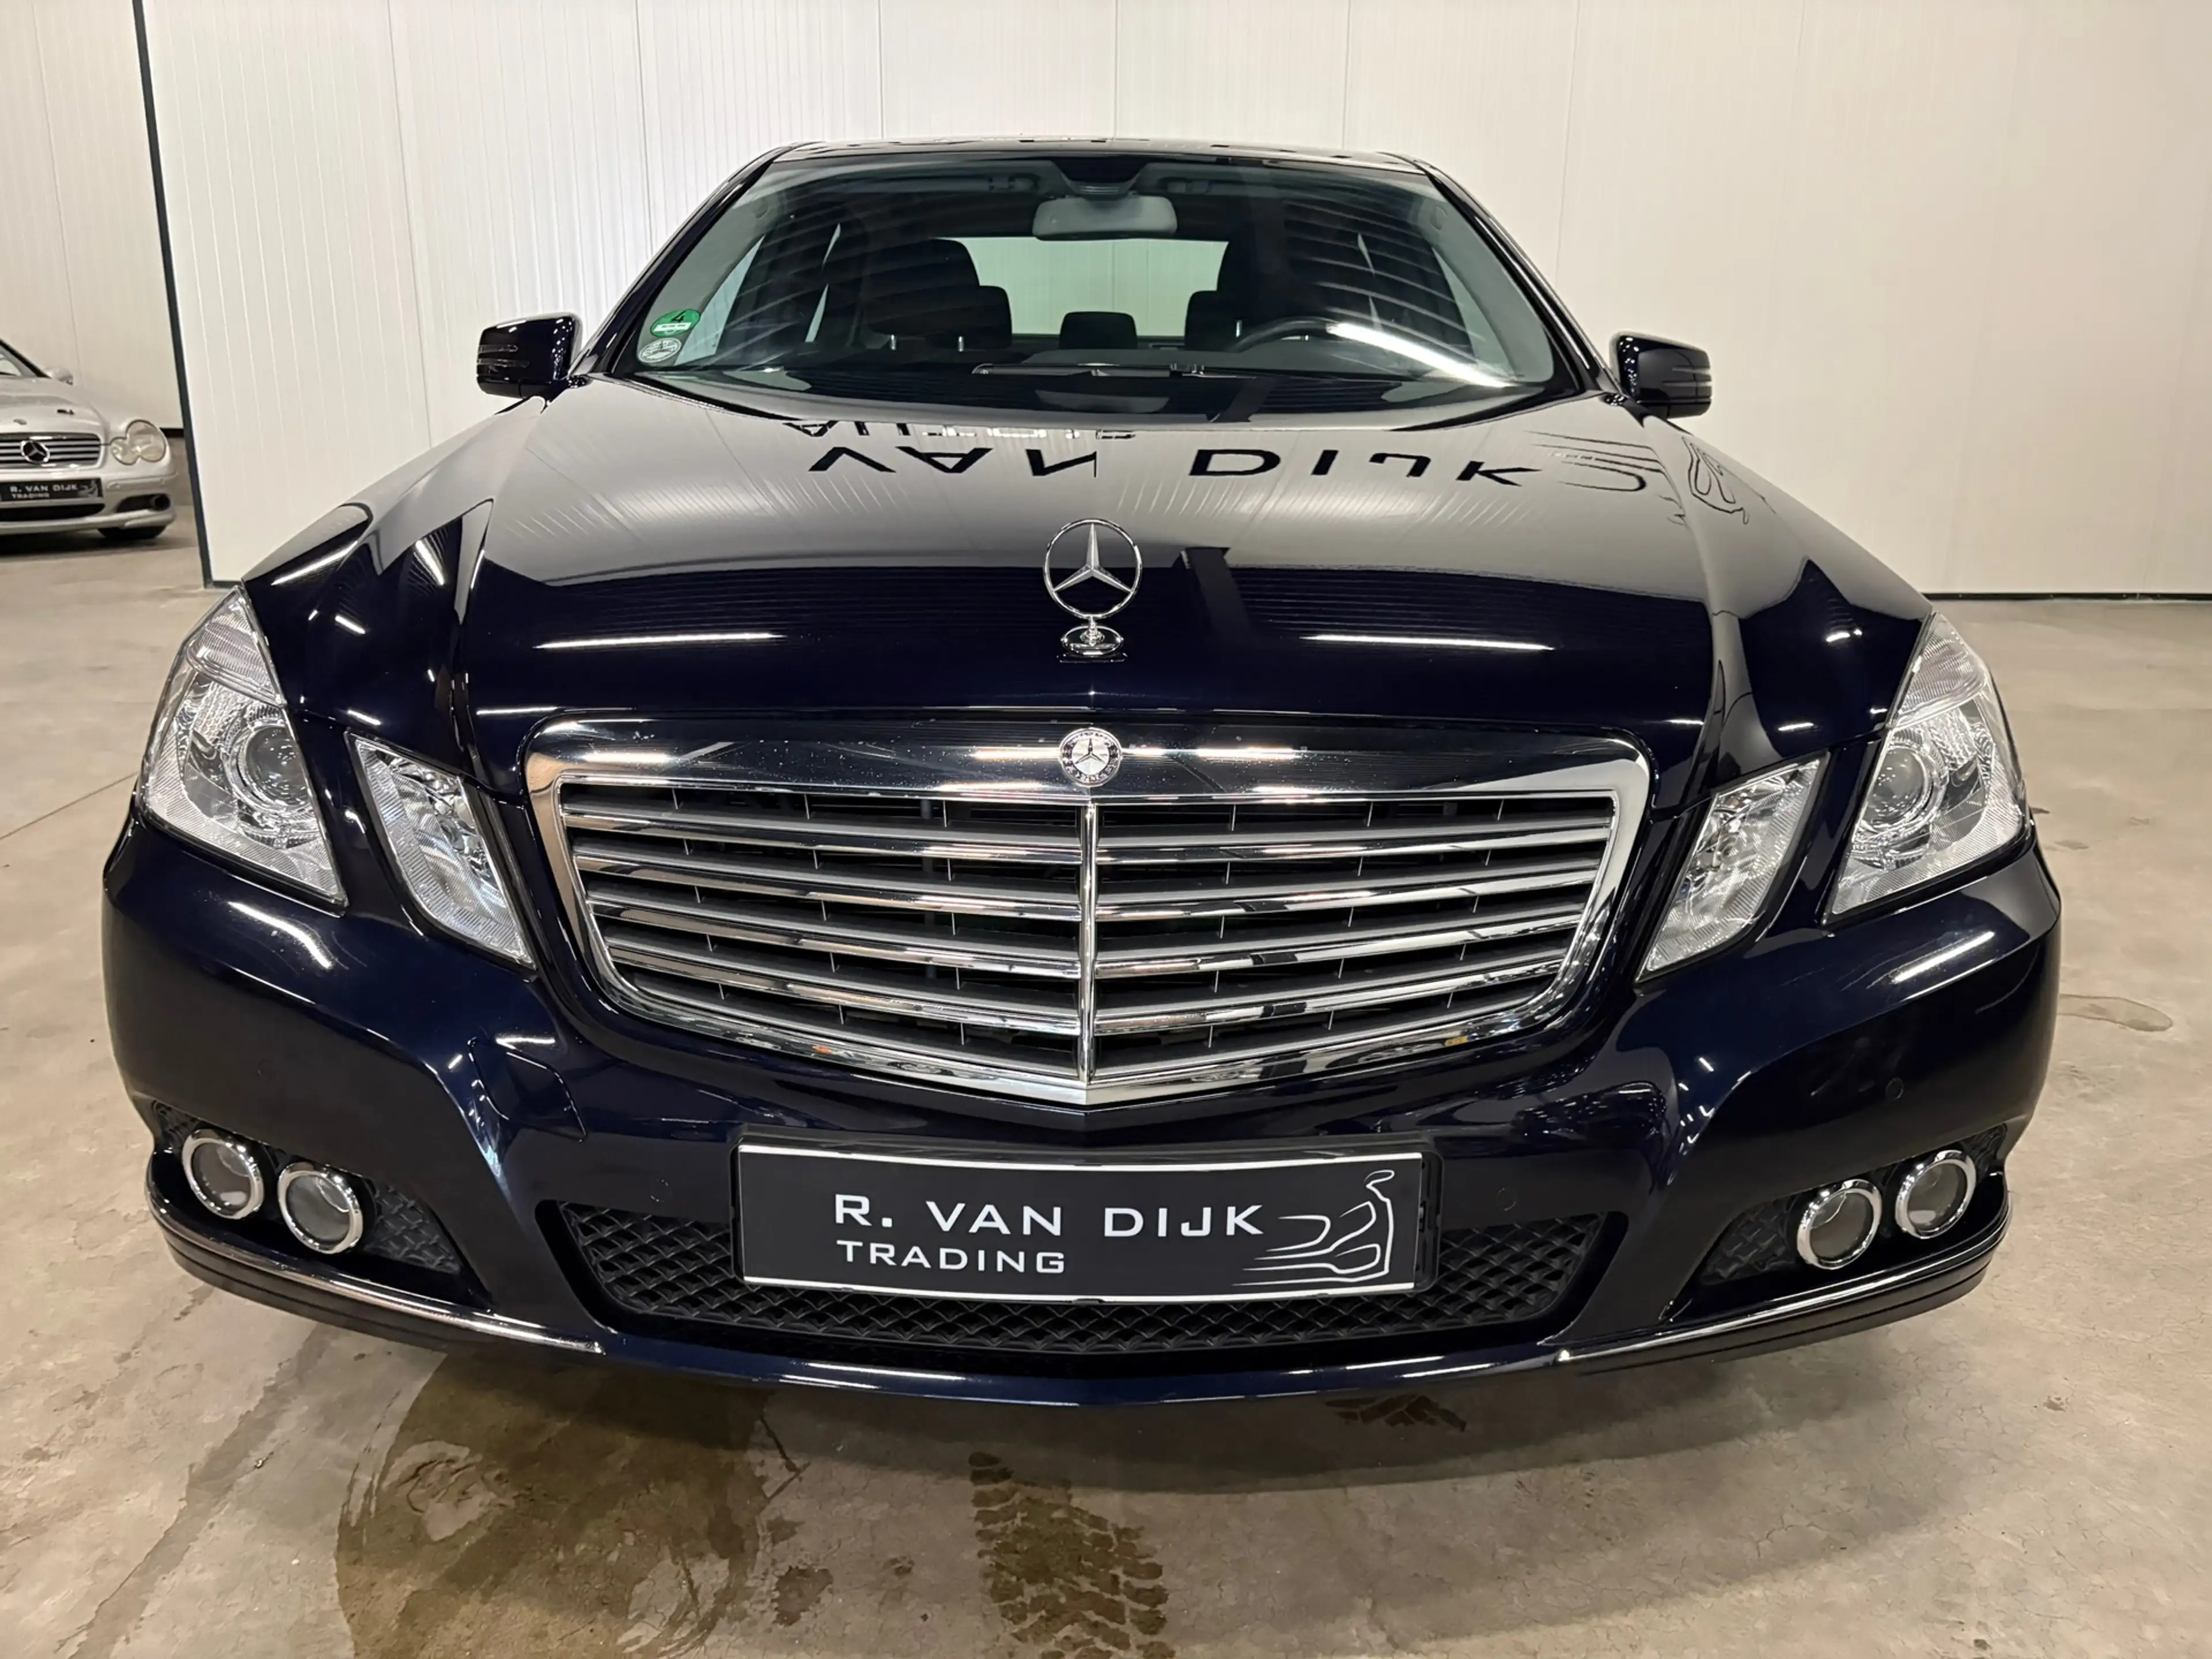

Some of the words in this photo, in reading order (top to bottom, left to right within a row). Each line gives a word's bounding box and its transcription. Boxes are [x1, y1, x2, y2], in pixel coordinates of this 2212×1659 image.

[671, 310, 685, 323] 4
[835, 1194, 892, 1228] R.
[926, 1200, 1061, 1236] VAN
[1104, 1205, 1264, 1237] DIJK
[836, 1240, 1065, 1274] TRADING
